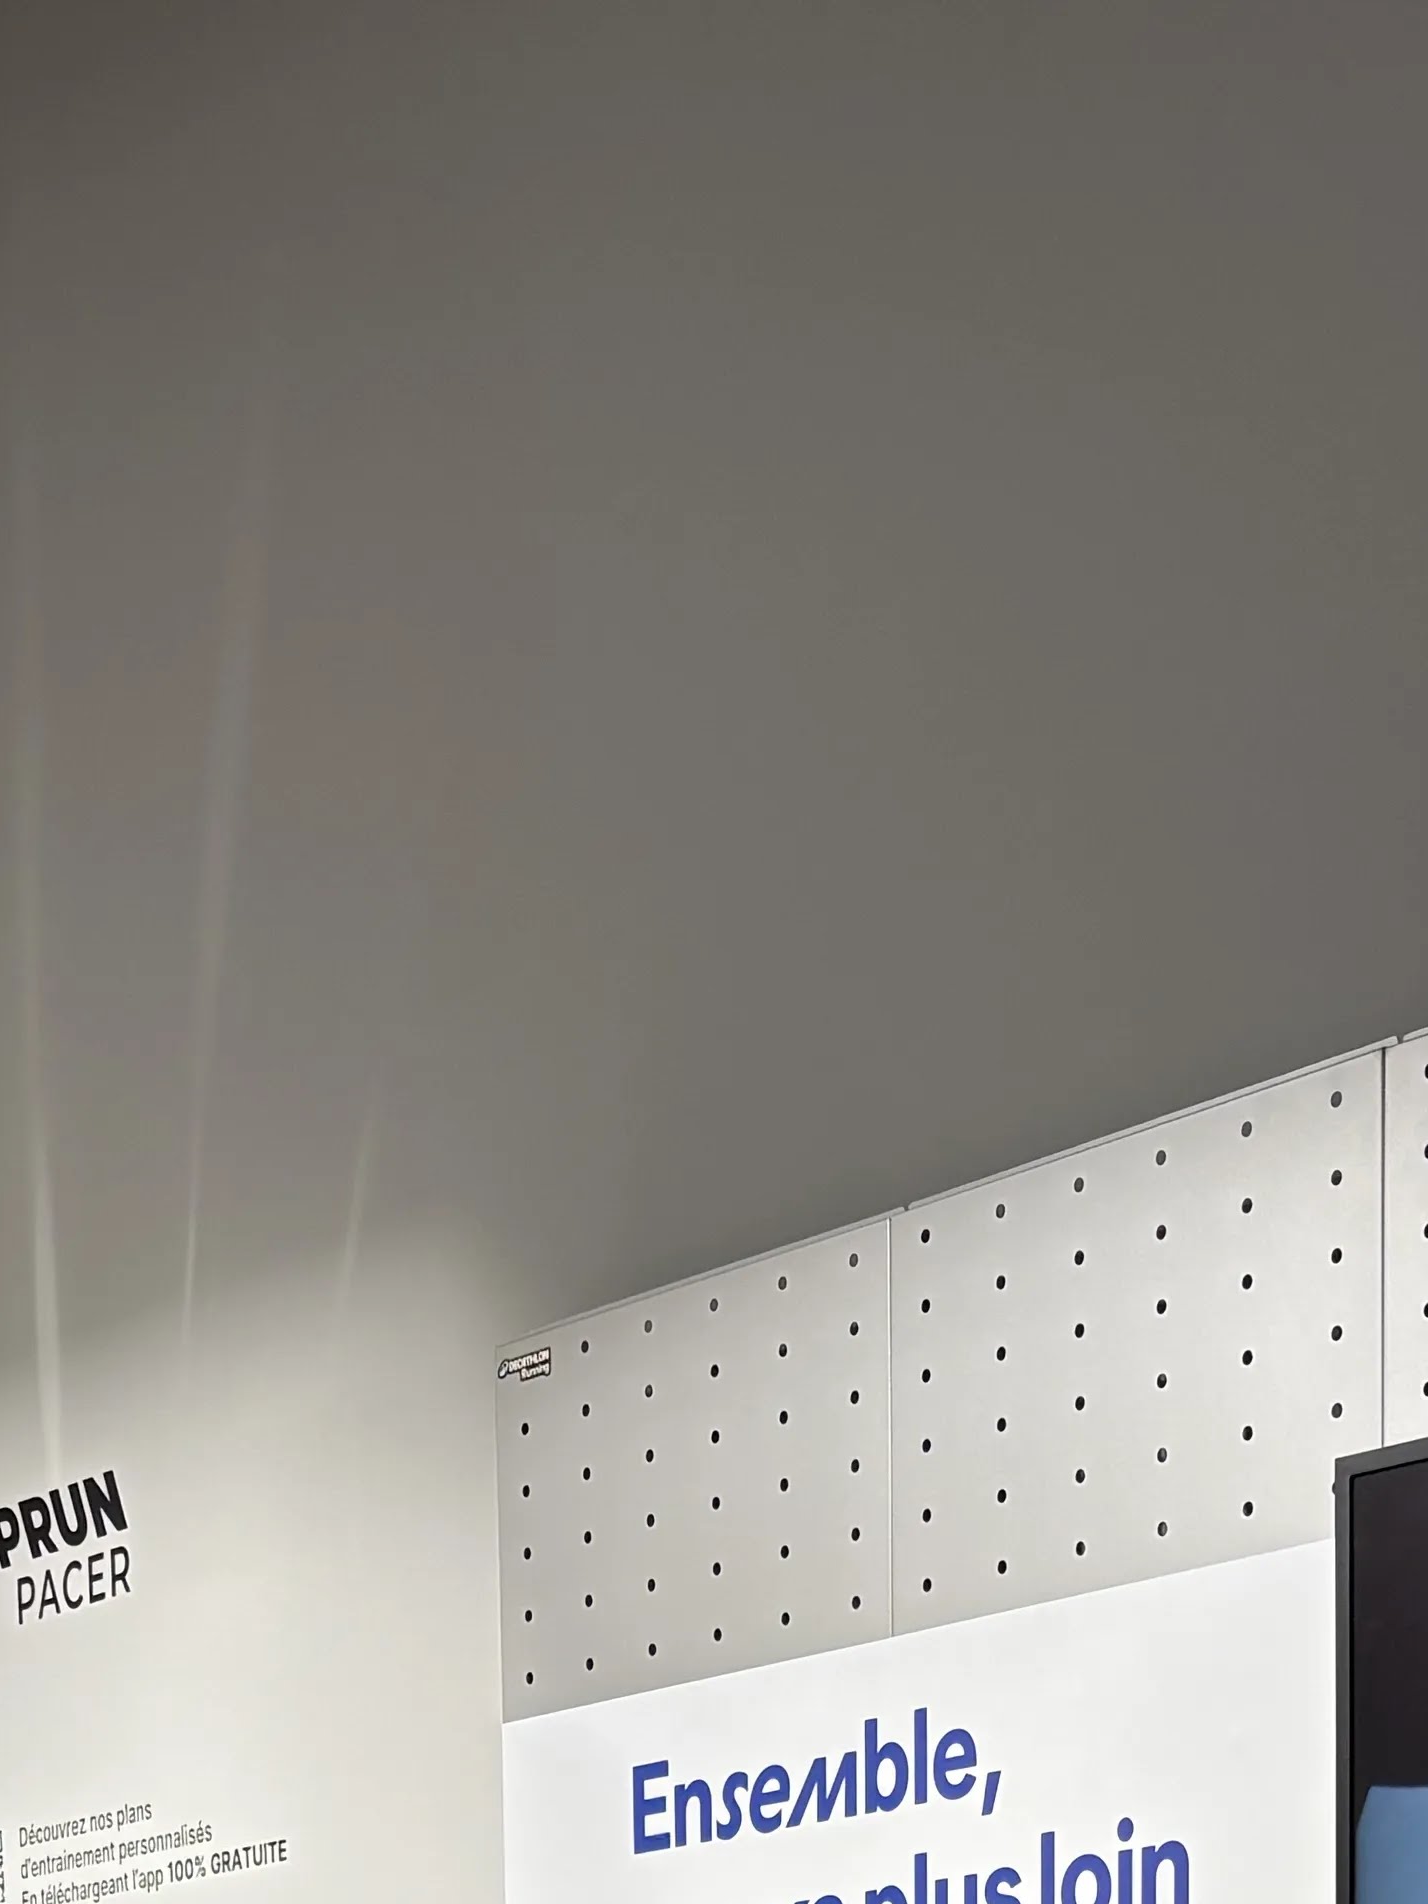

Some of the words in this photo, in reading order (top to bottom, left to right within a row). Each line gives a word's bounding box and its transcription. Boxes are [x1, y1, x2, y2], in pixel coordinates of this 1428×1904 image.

[16, 1545, 131, 1625] PACER
[631, 1706, 1002, 1855] Ensemble,
[19, 1817, 87, 1848] Découvrez
[90, 1812, 113, 1832] nos
[117, 1803, 152, 1832] plans
[21, 1841, 115, 1879] d'entrainement
[119, 1820, 213, 1865] personnalisés
[41, 1872, 129, 1903] téléchargeant
[132, 1867, 164, 1893] l'app
[167, 1855, 206, 1883] 100%
[211, 1839, 287, 1874] GRATUITE
